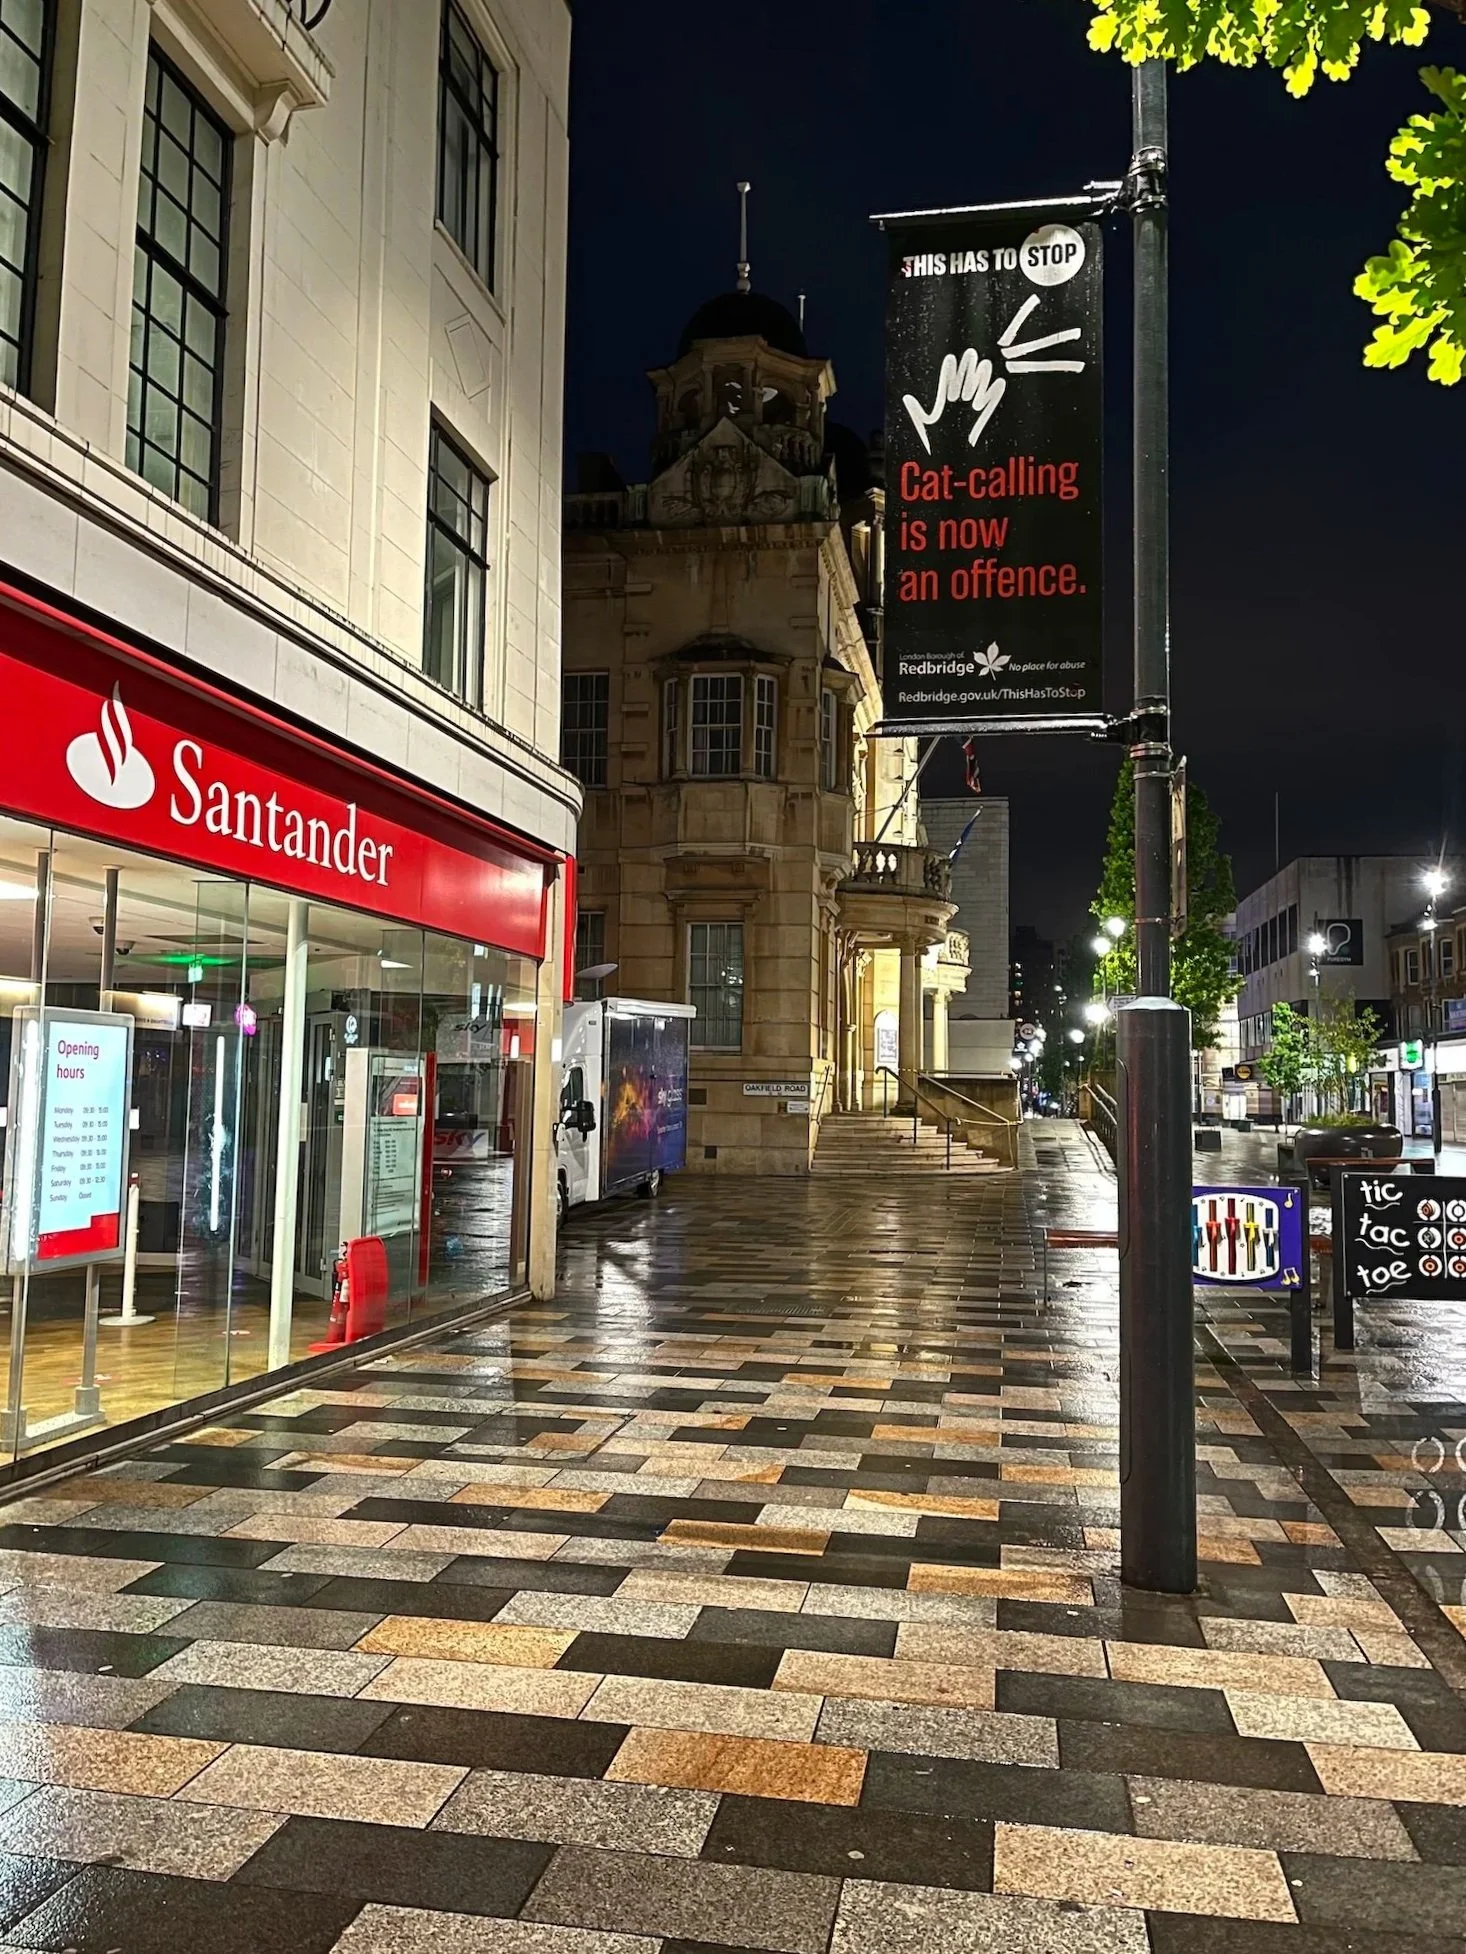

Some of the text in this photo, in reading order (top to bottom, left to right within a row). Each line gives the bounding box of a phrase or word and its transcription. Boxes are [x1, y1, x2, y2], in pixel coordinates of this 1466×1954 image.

[901, 242, 1078, 278] THIS HAS TO STOP
[901, 455, 1079, 501] Cat-calling
[901, 511, 1009, 551] is now
[900, 558, 1087, 601] an offence.
[899, 652, 926, 661] London
[926, 651, 956, 660] Borough
[1009, 660, 1086, 673] No place for abuse
[899, 660, 975, 677] Redbridge
[899, 686, 1086, 704] Redbridge.gov.uk/ThisHasToStop
[170, 739, 394, 887] Santander
[57, 1039, 100, 1060] Opening
[56, 1064, 85, 1079] hours
[745, 1084, 807, 1093] OAKFIELD ROAD
[1360, 1180, 1404, 1203] tic
[1359, 1212, 1411, 1247] tac
[1357, 1260, 1413, 1288] toe
